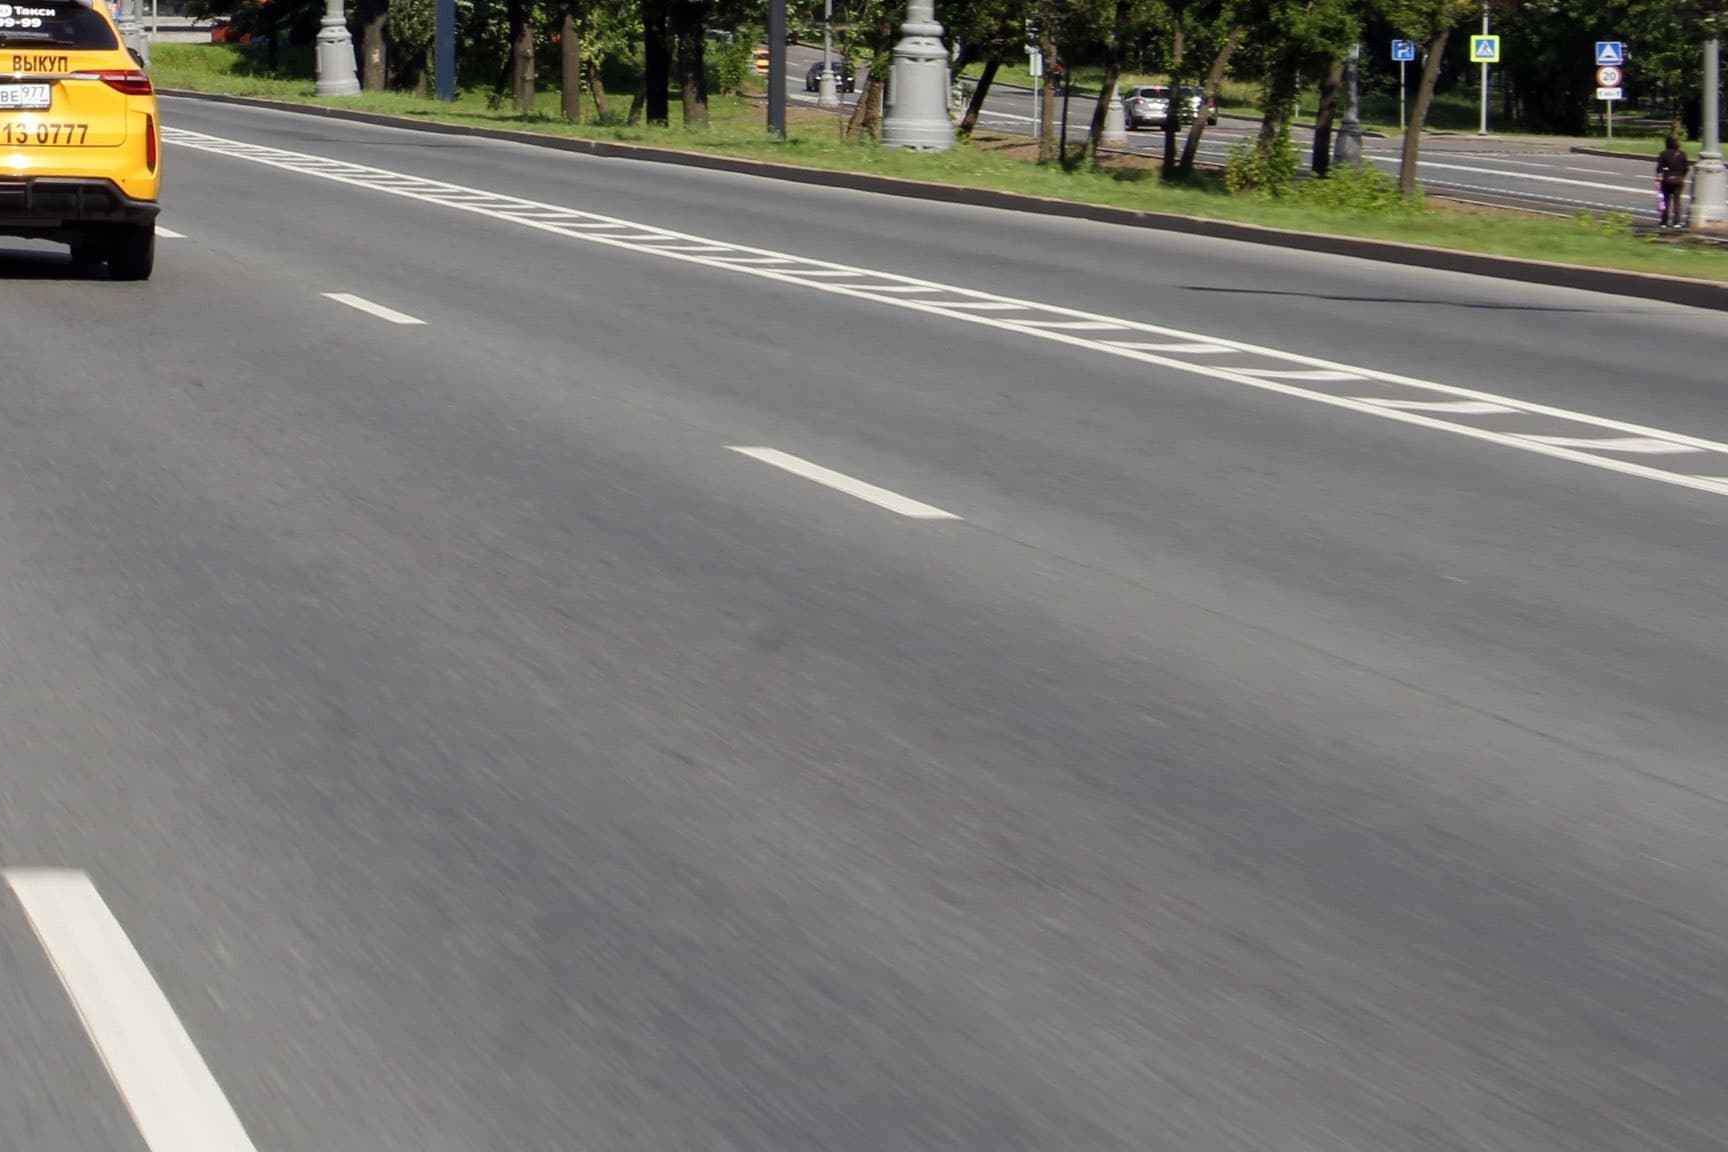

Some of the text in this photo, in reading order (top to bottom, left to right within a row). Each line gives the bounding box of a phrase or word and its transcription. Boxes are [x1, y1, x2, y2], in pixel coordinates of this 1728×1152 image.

[13, 5, 56, 17] Такси
[12, 55, 68, 72] ВЫКУП
[1602, 71, 1617, 81] 20
[22, 86, 45, 98] 977
[36, 123, 89, 145] 0777
